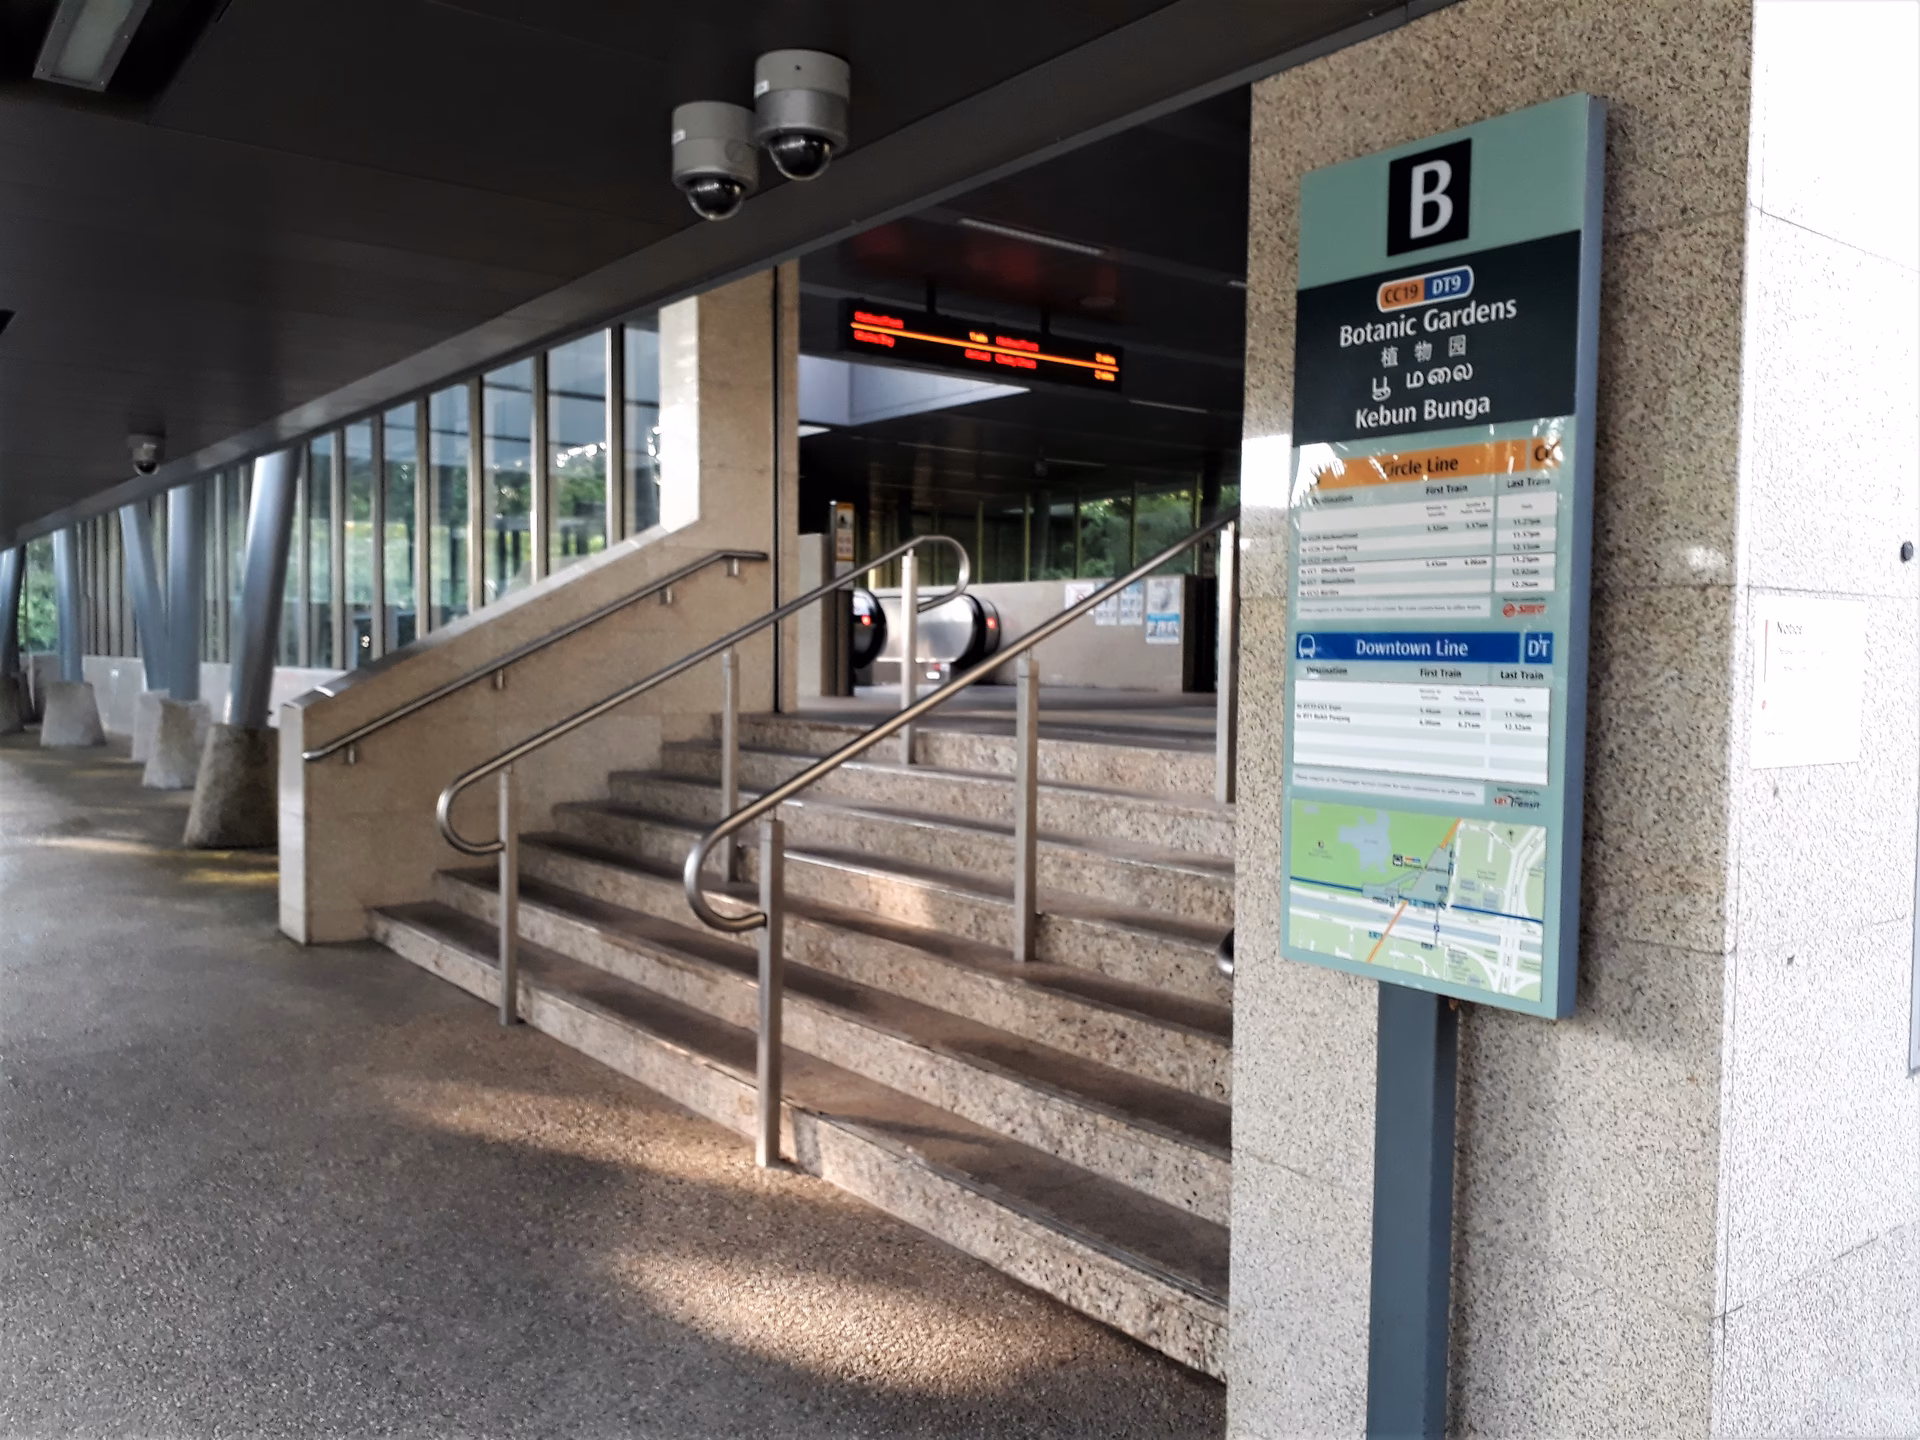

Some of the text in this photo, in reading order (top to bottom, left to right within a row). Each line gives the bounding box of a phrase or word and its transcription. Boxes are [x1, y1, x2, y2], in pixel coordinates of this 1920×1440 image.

[1409, 159, 1453, 240] B
[1384, 275, 1462, 304] CC19 DT9
[1340, 299, 1517, 347] Botanic Gardens
[1381, 334, 1467, 369] 植物园
[1355, 395, 1491, 430] Kebun Bunga
[1382, 456, 1459, 477] Circle Line
[1425, 484, 1468, 495] First Train
[1506, 477, 1551, 489] Last Train
[1356, 639, 1469, 657] Downtown Line
[1528, 639, 1550, 658] DT
[1420, 668, 1462, 679] First Train
[1500, 670, 1544, 681] Last Train
